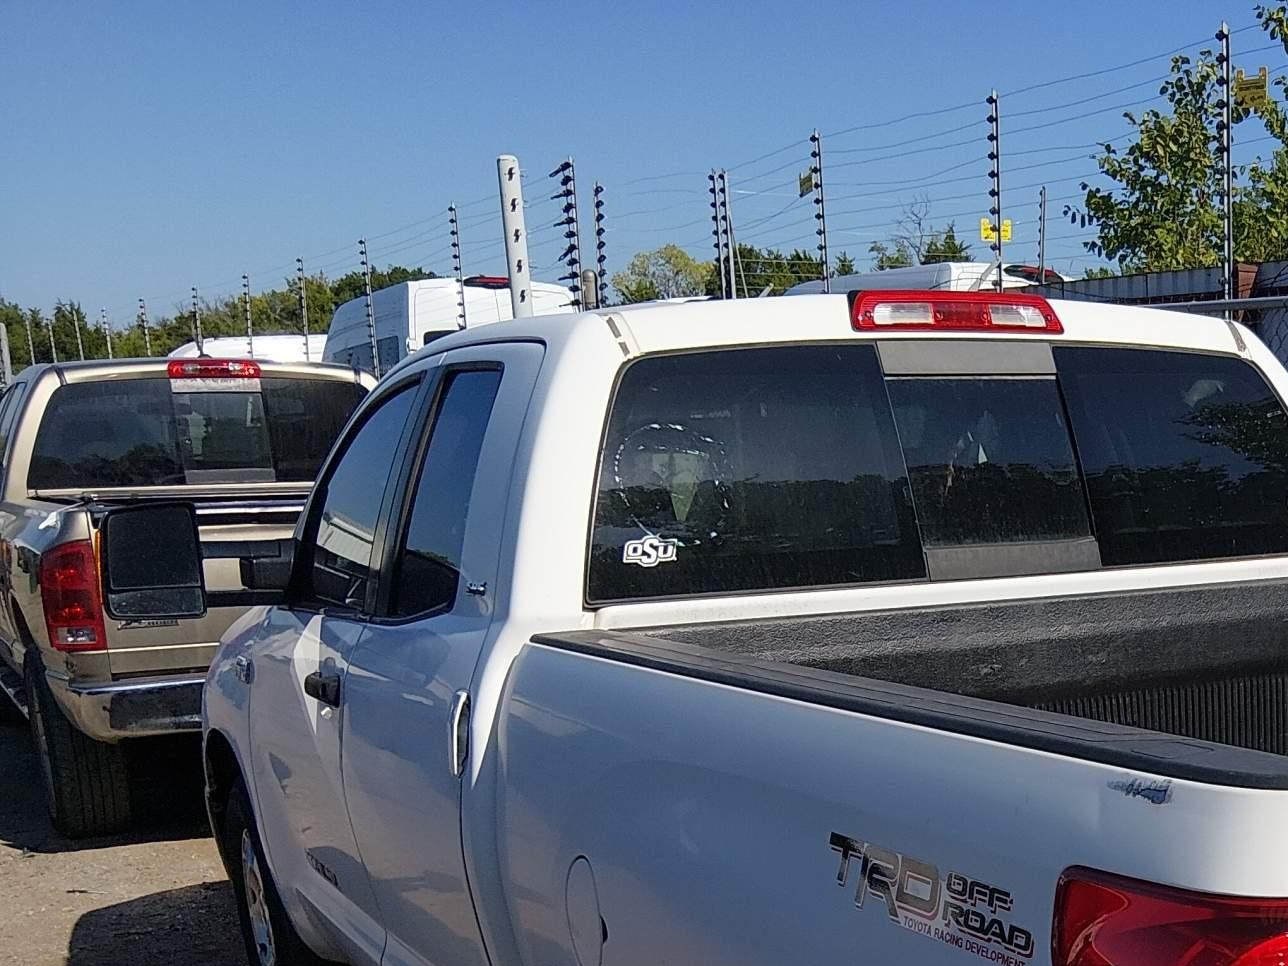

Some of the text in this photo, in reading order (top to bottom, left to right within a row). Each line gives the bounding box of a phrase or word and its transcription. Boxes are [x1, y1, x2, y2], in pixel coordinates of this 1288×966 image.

[626, 537, 674, 564] OSU
[829, 832, 942, 924] TRD
[946, 871, 1013, 913] OFF
[903, 916, 932, 936] TOYOTA
[933, 926, 963, 949] RACING
[942, 903, 1034, 958] ROAD
